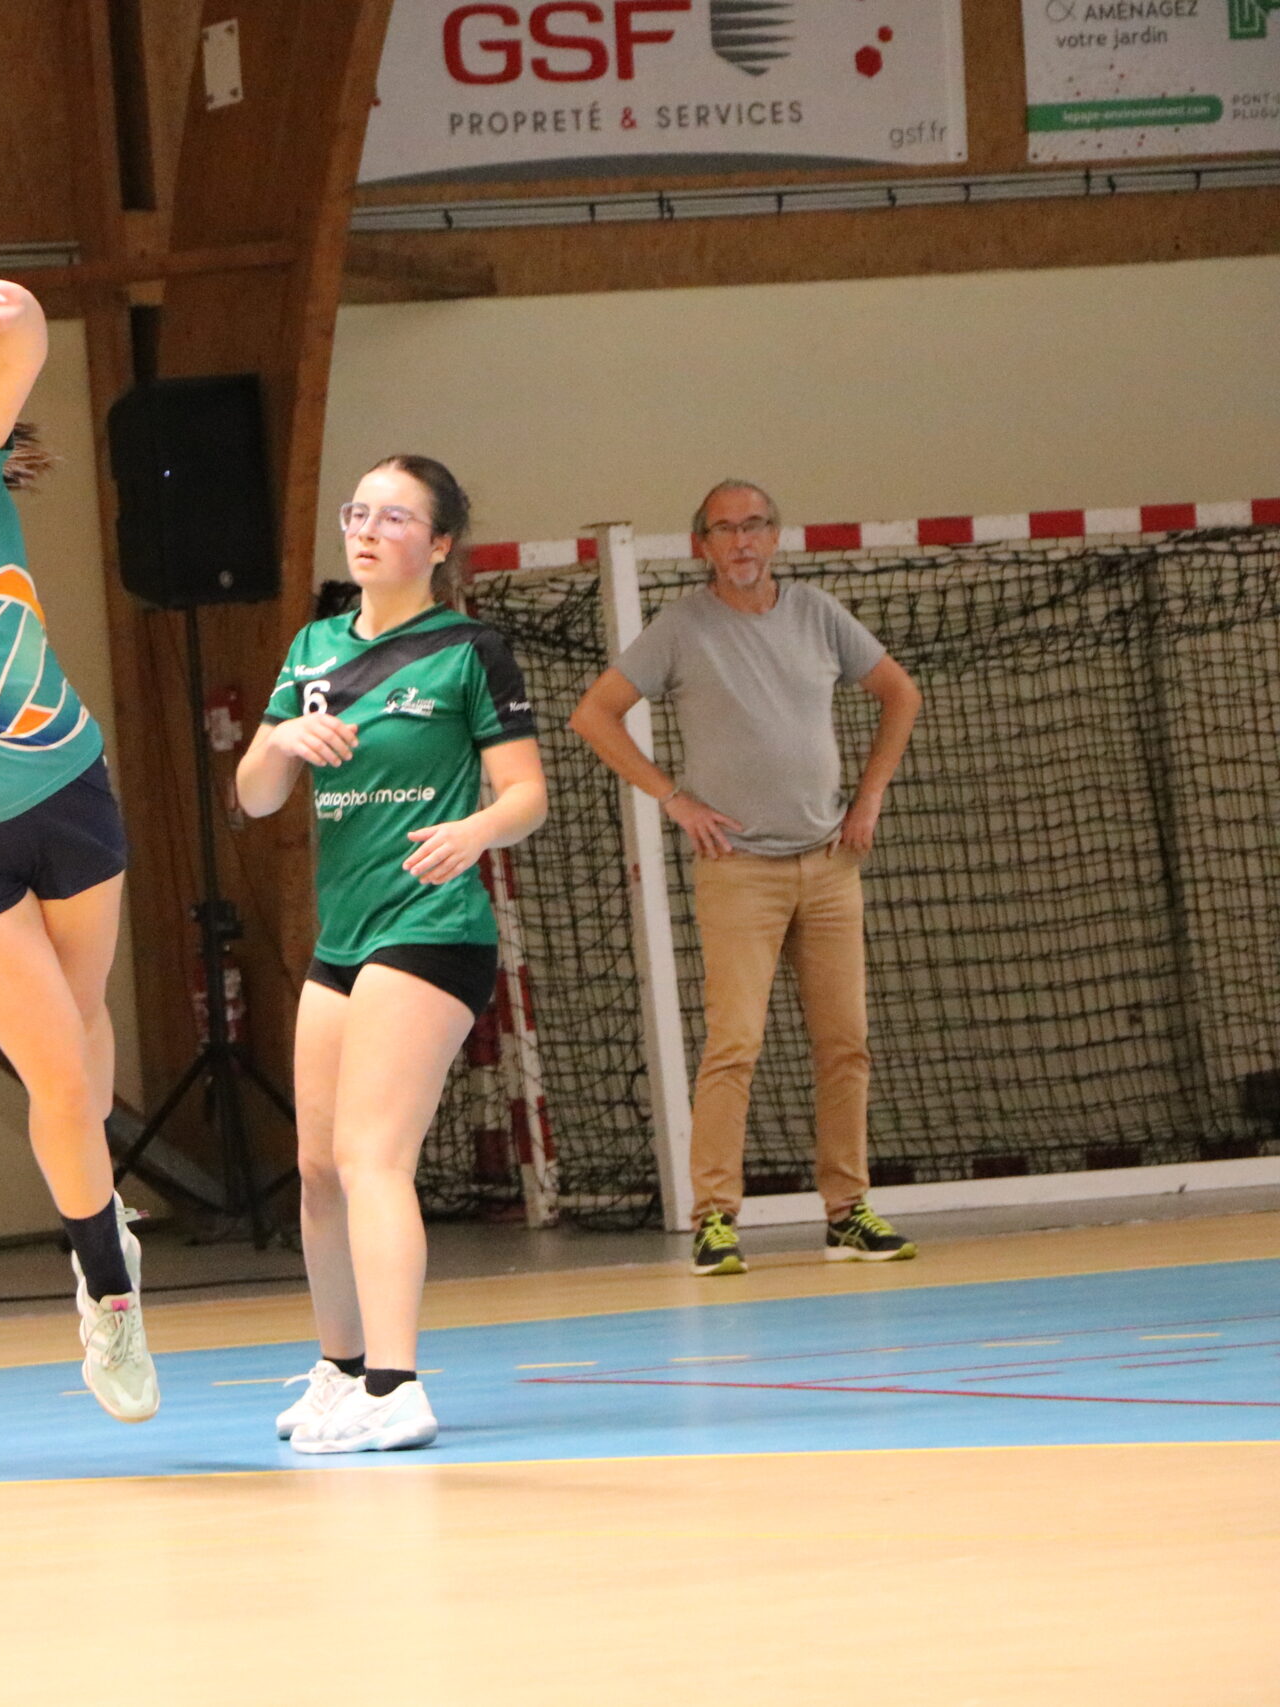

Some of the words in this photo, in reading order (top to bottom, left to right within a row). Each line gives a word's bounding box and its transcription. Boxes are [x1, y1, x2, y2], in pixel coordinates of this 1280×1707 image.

[442, 0, 692, 86] GSF
[1055, 32, 1107, 49] votre
[1113, 25, 1169, 49] jardin
[449, 102, 603, 137] PROPRETÉ
[620, 105, 638, 130] &
[656, 100, 805, 130] SERVICES
[889, 120, 948, 150] gsf.fr
[303, 680, 331, 715] 6
